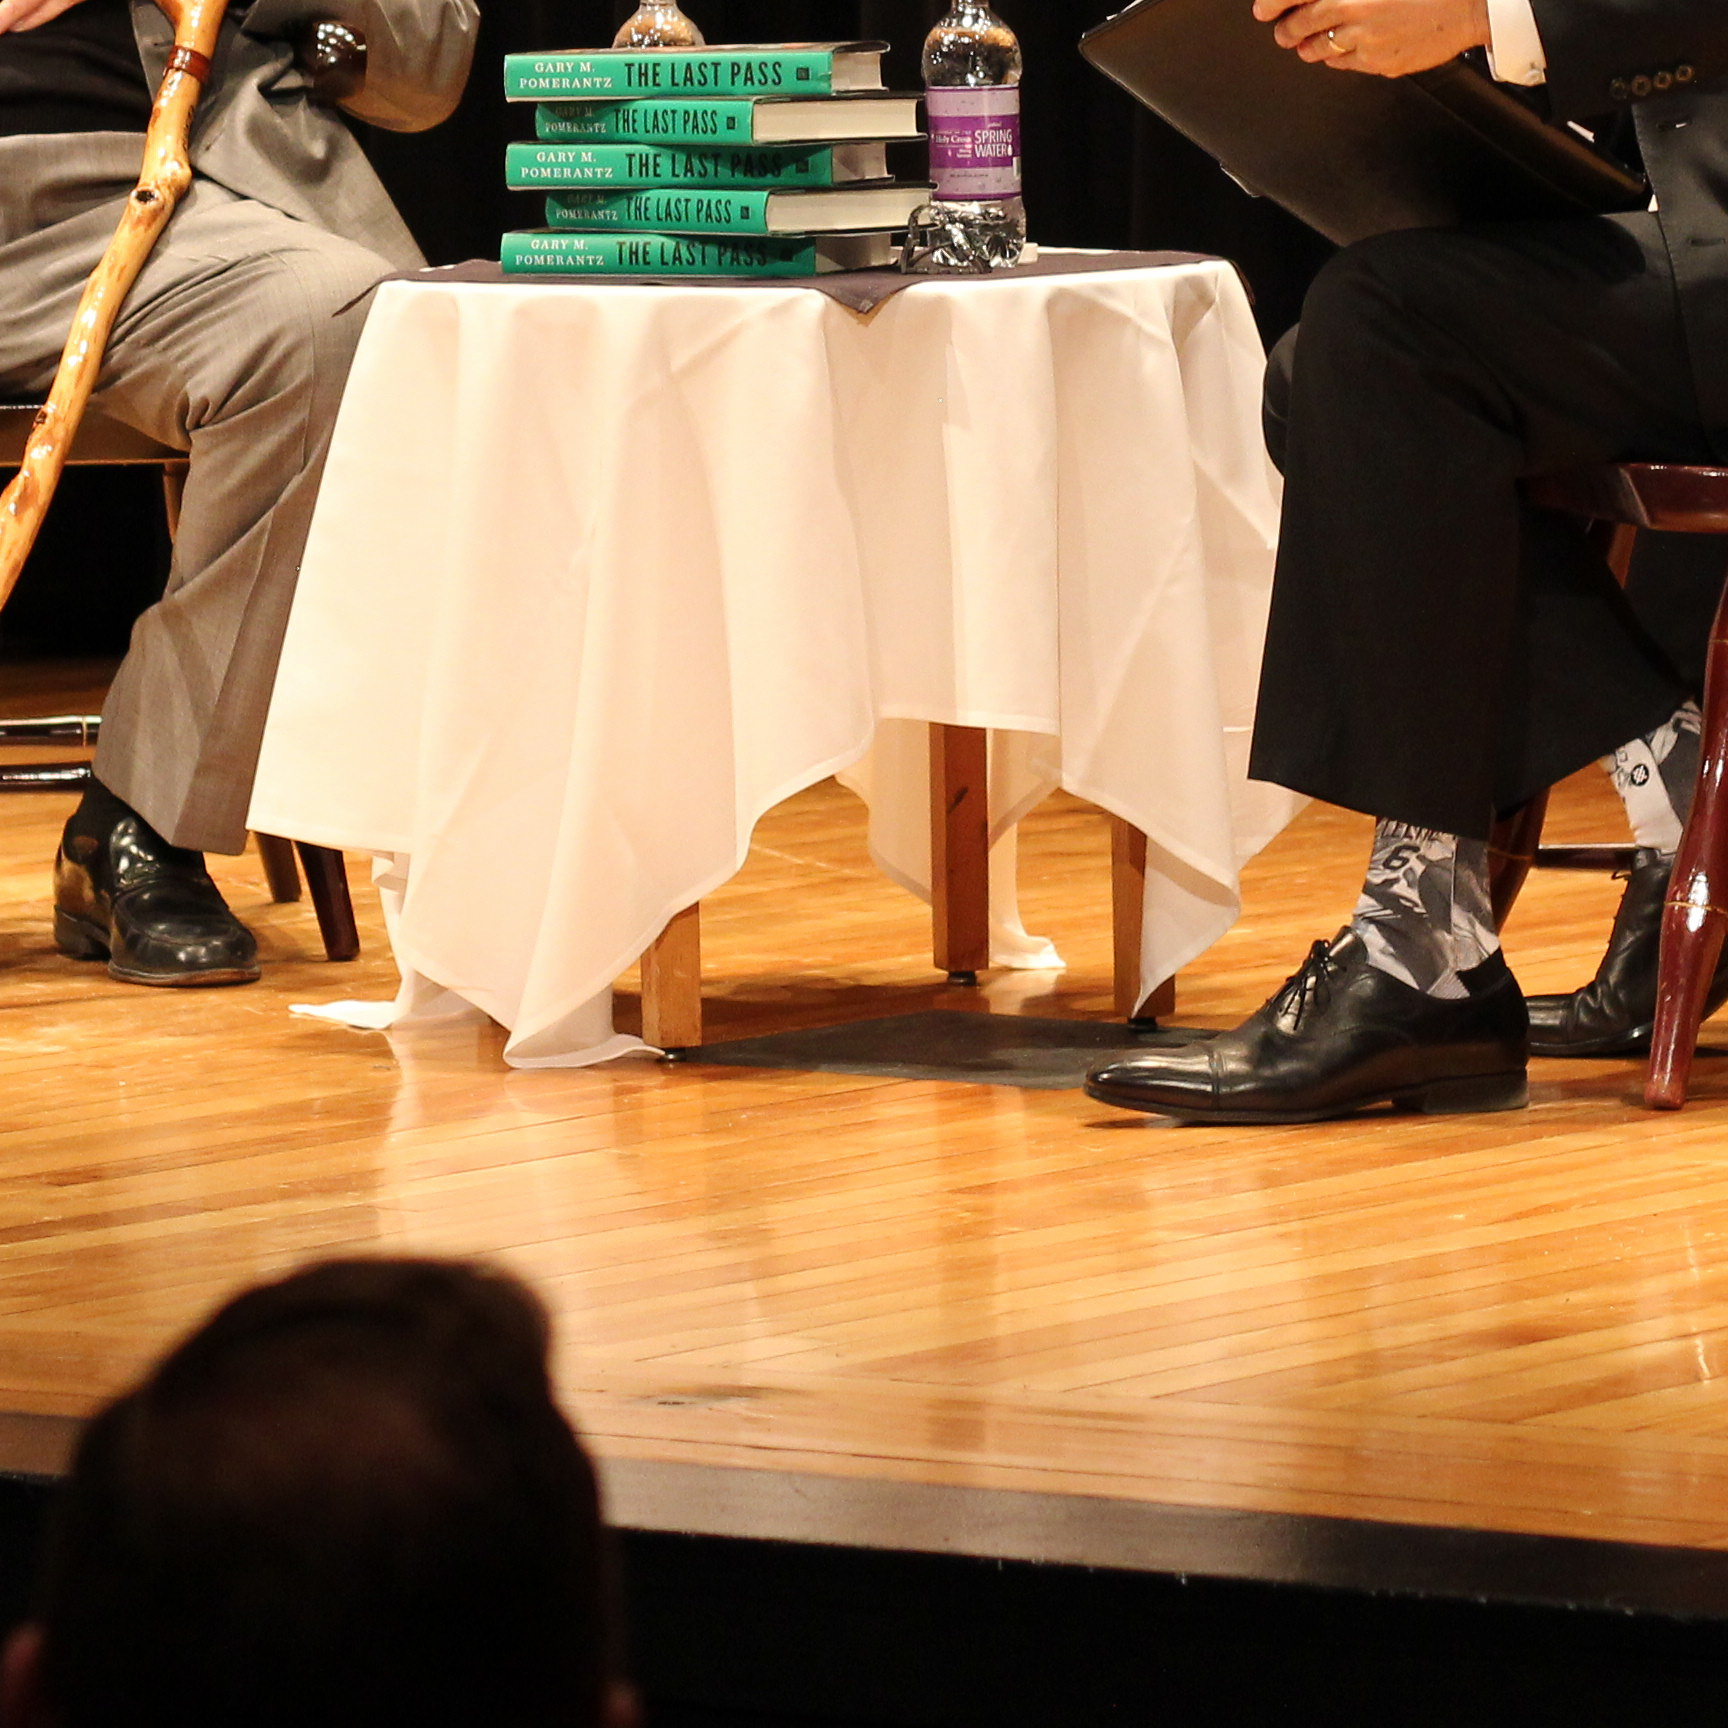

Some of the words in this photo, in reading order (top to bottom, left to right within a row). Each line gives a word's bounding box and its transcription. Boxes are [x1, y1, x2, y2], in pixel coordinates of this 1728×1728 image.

[534, 61, 575, 73] GARY
[579, 62, 595, 73] M.
[624, 62, 661, 87] THE
[670, 62, 721, 87] LAST
[730, 61, 782, 86] PASS
[519, 77, 612, 89] POMERANTZ
[545, 121, 606, 133] POMERANTZ
[613, 109, 638, 133] THE
[644, 109, 677, 134] LAST
[683, 109, 717, 134] PASS
[974, 128, 1013, 144] SPRING
[974, 143, 1007, 158] WATER
[536, 152, 576, 163] GARY
[580, 152, 596, 162] M.
[625, 153, 662, 178] THE
[672, 153, 721, 178] LAST
[730, 153, 783, 178] PASS
[520, 167, 613, 178] POMERANTZ
[555, 209, 618, 221] POMERANTZ
[625, 197, 650, 221] THE
[656, 197, 691, 222] LAST
[696, 198, 732, 223] PASS
[531, 239, 569, 250] GARY
[573, 239, 588, 250] M.
[515, 254, 604, 265] POMERANTZ
[616, 241, 651, 266] THE
[660, 241, 707, 266] LAST
[717, 242, 767, 266] PASS
[1383, 845, 1420, 869] 6
